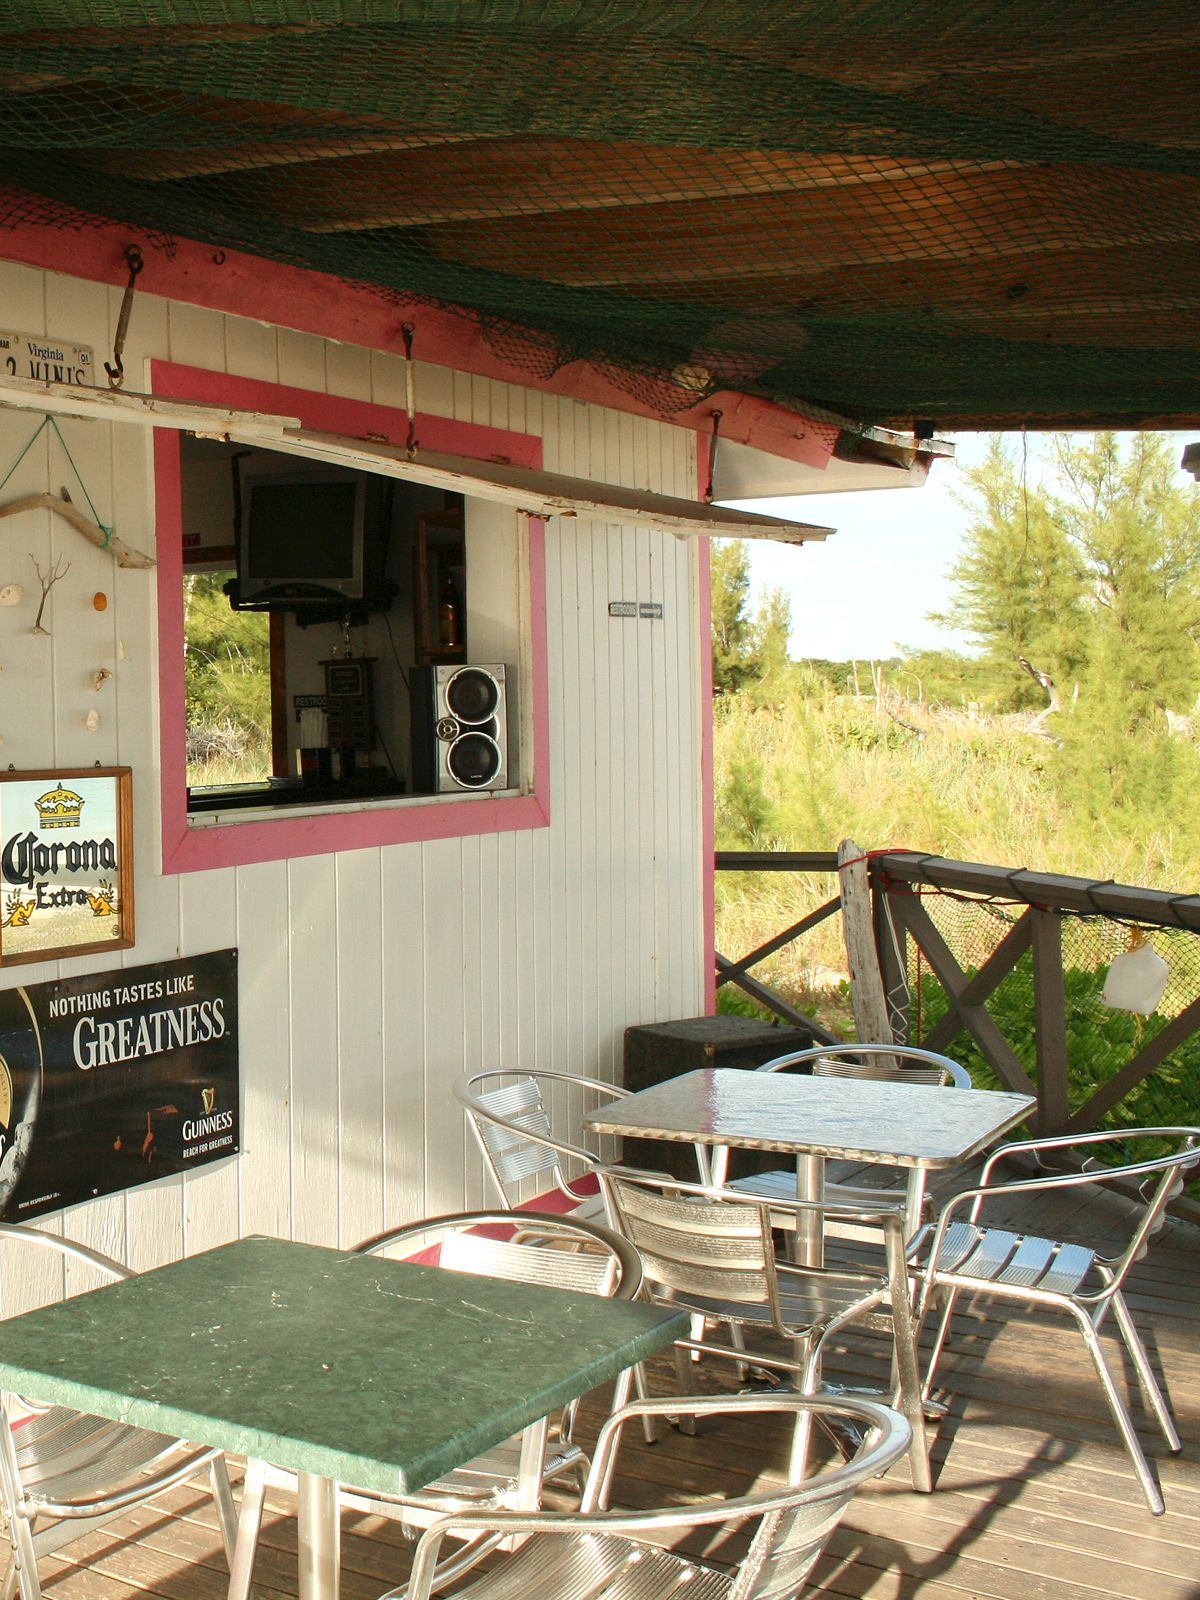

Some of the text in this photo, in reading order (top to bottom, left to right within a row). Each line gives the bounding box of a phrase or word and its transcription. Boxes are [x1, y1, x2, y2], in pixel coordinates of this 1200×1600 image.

[27, 342, 64, 361] Virginia
[2, 832, 116, 889] Corona
[35, 881, 89, 910] Extra
[49, 974, 195, 1018] NOTHING TASTES LIKE
[72, 998, 226, 1071] GREATNESS
[182, 1110, 233, 1141] GUINNESS
[182, 1135, 233, 1159] REACH FOR GREATNESS
